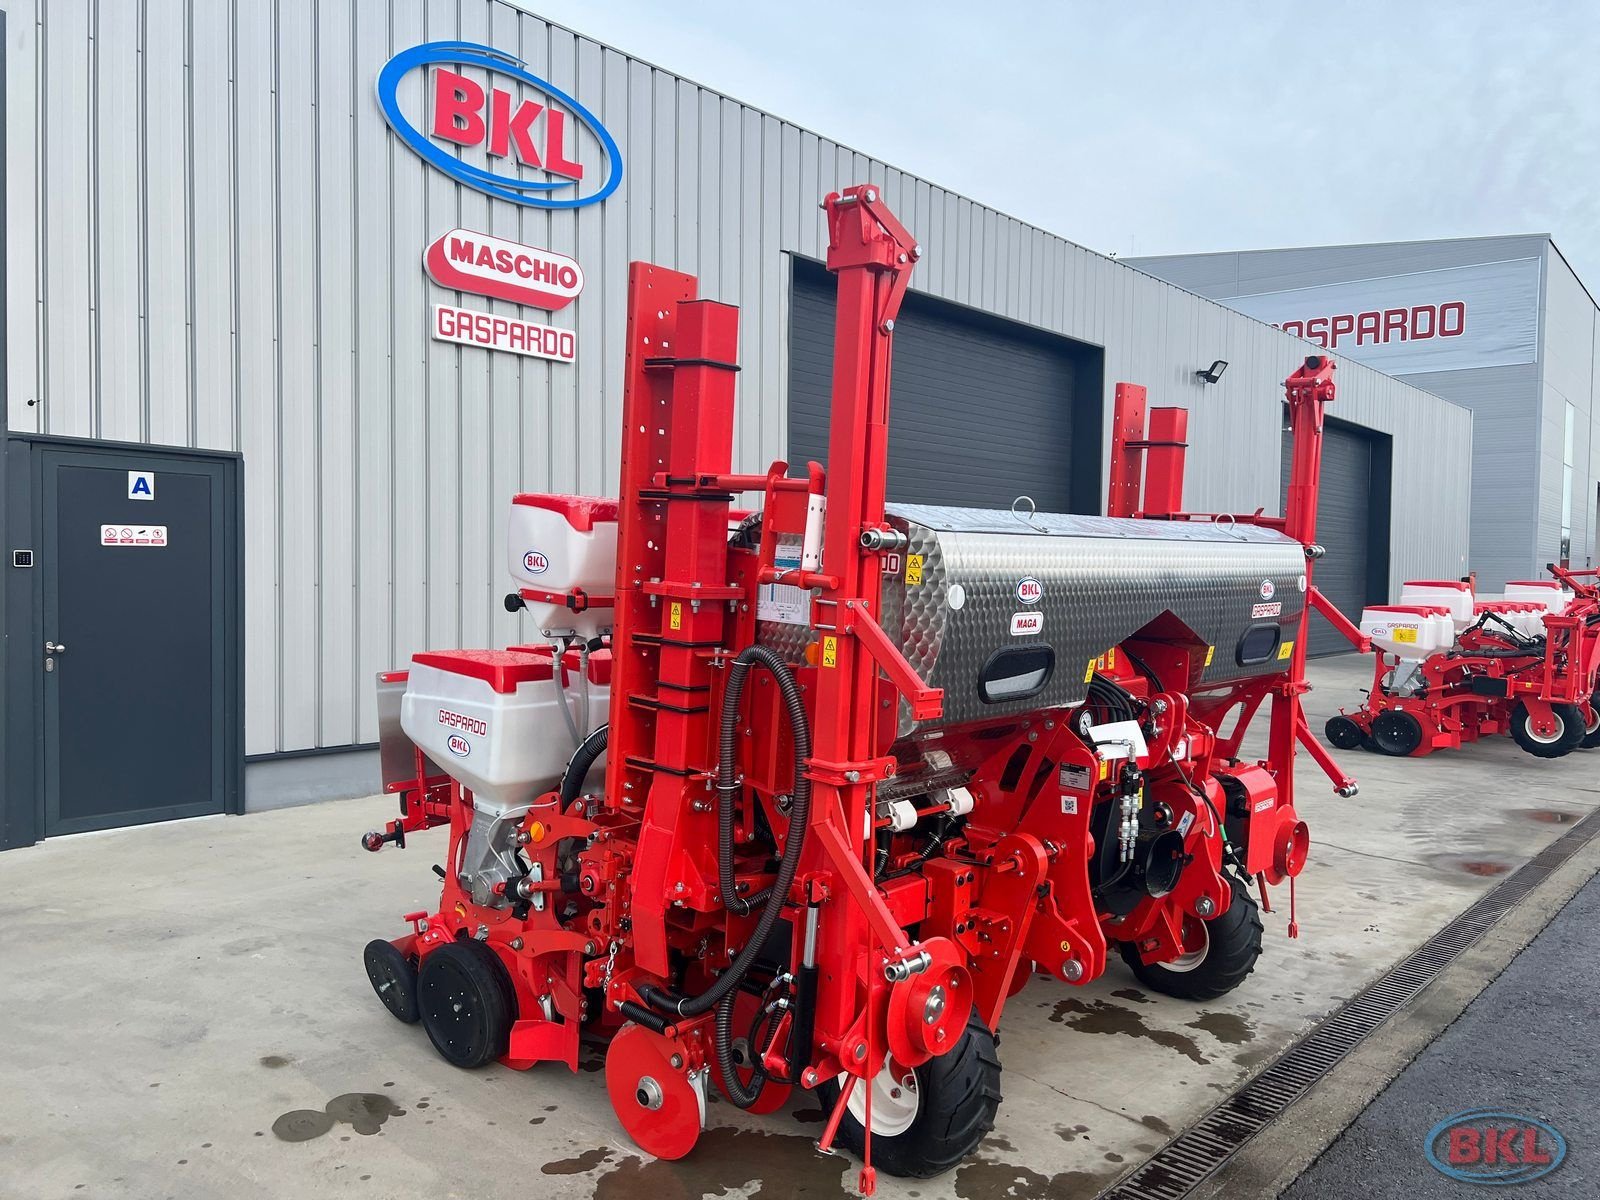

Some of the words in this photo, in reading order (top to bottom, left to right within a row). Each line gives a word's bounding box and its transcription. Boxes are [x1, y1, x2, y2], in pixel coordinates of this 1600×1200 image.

[432, 67, 583, 180] BKL
[450, 237, 578, 289] MASCHIO
[438, 307, 574, 359] GASPARDO
[1271, 301, 1466, 349] SPARDO
[131, 477, 152, 495] A
[527, 555, 545, 567] BKL
[1021, 583, 1039, 596] BKL
[1016, 618, 1037, 629] MAGA
[1386, 622, 1419, 630] GASPARDO
[438, 709, 487, 736] GASPARDO
[451, 737, 468, 753] BKL
